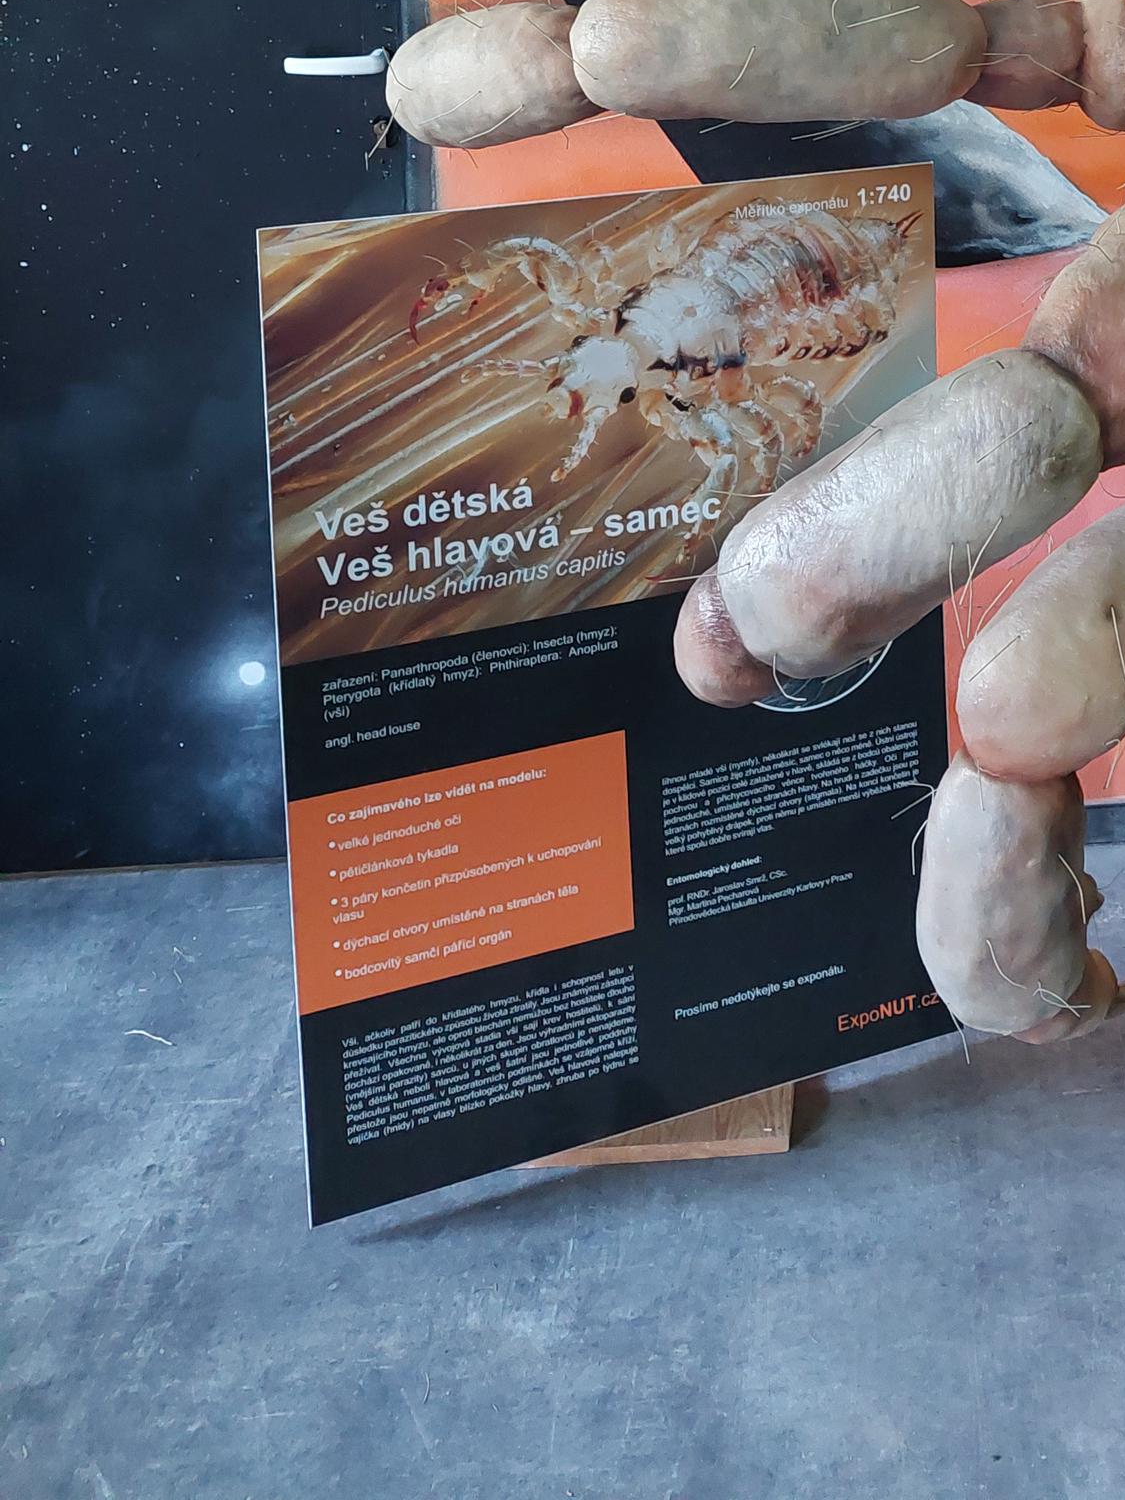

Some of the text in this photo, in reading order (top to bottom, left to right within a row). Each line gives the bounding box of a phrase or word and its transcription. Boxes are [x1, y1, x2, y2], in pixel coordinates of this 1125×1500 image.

[734, 182, 911, 220] Měřítko exponátu 1:740
[314, 477, 533, 541] Veš dětská
[316, 543, 393, 586] Veš
[407, 516, 559, 571] hlavová
[603, 493, 721, 538] samec
[319, 545, 626, 620] Pediculus humanus capitis
[321, 625, 617, 691] zařazení: Panarthropoda (členovci): Insecta (hmyz):
[323, 640, 617, 705] Pterygota (křídlatý hmyz): Phthiraptera: Anoplura
[323, 705, 350, 722] (vši)
[324, 721, 420, 748] angl. head louse
[326, 768, 546, 824] Co zajímavého lze vidět na modelu:
[337, 813, 461, 851] velké jednoduché oči
[339, 843, 458, 882] pětičlánková tykadla
[340, 835, 601, 907] 3 páry končetin přizpůsobených k uchopování
[666, 855, 761, 886] Entomologický dohled:
[668, 885, 759, 916] Mgr. Martina Pecharová
[712, 880, 744, 895] Jaroslav
[758, 887, 795, 902] Univerzity
[796, 879, 824, 892] Karlovy
[830, 872, 852, 883] Praze
[332, 909, 364, 924] vlasu
[342, 884, 578, 951] dýchací otvory umístěné na stranách těla
[344, 929, 511, 979] bodcovitý samčí pářicí orgán
[342, 1041, 383, 1058] důsledku
[384, 1026, 443, 1049] parazitického
[444, 1015, 481, 1032] způsobu
[482, 1008, 508, 1021] života
[540, 994, 560, 1005] Jsou
[561, 981, 599, 1000] známými
[600, 972, 634, 989] zástupci
[364, 1027, 395, 1042] ačkoliv
[425, 1016, 437, 1025] do
[441, 1004, 485, 1021] křídlatého
[489, 994, 521, 1008] hmyzu,
[561, 971, 604, 989] schopnost
[398, 1040, 431, 1054] hmyzu,
[432, 1035, 446, 1045] ale
[447, 1026, 473, 1041] oproti
[474, 1018, 511, 1034] blechám
[553, 1002, 569, 1012] bez
[570, 992, 605, 1007] hostitele
[606, 984, 635, 997] dlouho
[674, 965, 846, 1020] Prosíme nedotýkejte se exponátu.
[837, 992, 940, 1032] ExpoNUT.cz
[343, 1062, 382, 1082] přežívat.
[387, 1051, 427, 1068] Všechna
[431, 1038, 470, 1057] vývojová
[474, 1031, 501, 1044] stadia
[542, 1014, 561, 1025] krev
[617, 992, 635, 1005] sání
[345, 1099, 363, 1112] Veš
[368, 1090, 398, 1106] dětská
[403, 1081, 430, 1096] neboli
[435, 1070, 469, 1087] hlavová
[485, 1061, 501, 1073] veš
[505, 1054, 526, 1067] šatní
[531, 1049, 549, 1063] jsou
[554, 1035, 593, 1056] jednotlivé
[598, 1024, 637, 1043] poddruhy
[346, 1104, 390, 1123] Pediculus
[392, 1092, 436, 1110] humanus,
[447, 1071, 505, 1094] laboratorních
[507, 1056, 559, 1079] podmínkách
[561, 1053, 572, 1062] se
[347, 1117, 385, 1136] přestože
[389, 1110, 408, 1124] jsou
[411, 1097, 450, 1116] nepatrně
[454, 1082, 508, 1104] morfologicky
[548, 1064, 564, 1076] Veš
[567, 1055, 600, 1071] hlavová
[603, 1045, 638, 1061] nalepuje
[347, 1130, 379, 1144] vajíčka
[383, 1118, 414, 1136] (hnidy)
[417, 1115, 429, 1125] na
[432, 1108, 456, 1120] vlasy
[459, 1099, 485, 1113] blízko
[488, 1088, 524, 1106] pokožky
[587, 1067, 599, 1077] po
[602, 1059, 625, 1073] týdnu
[628, 1055, 639, 1064] se
